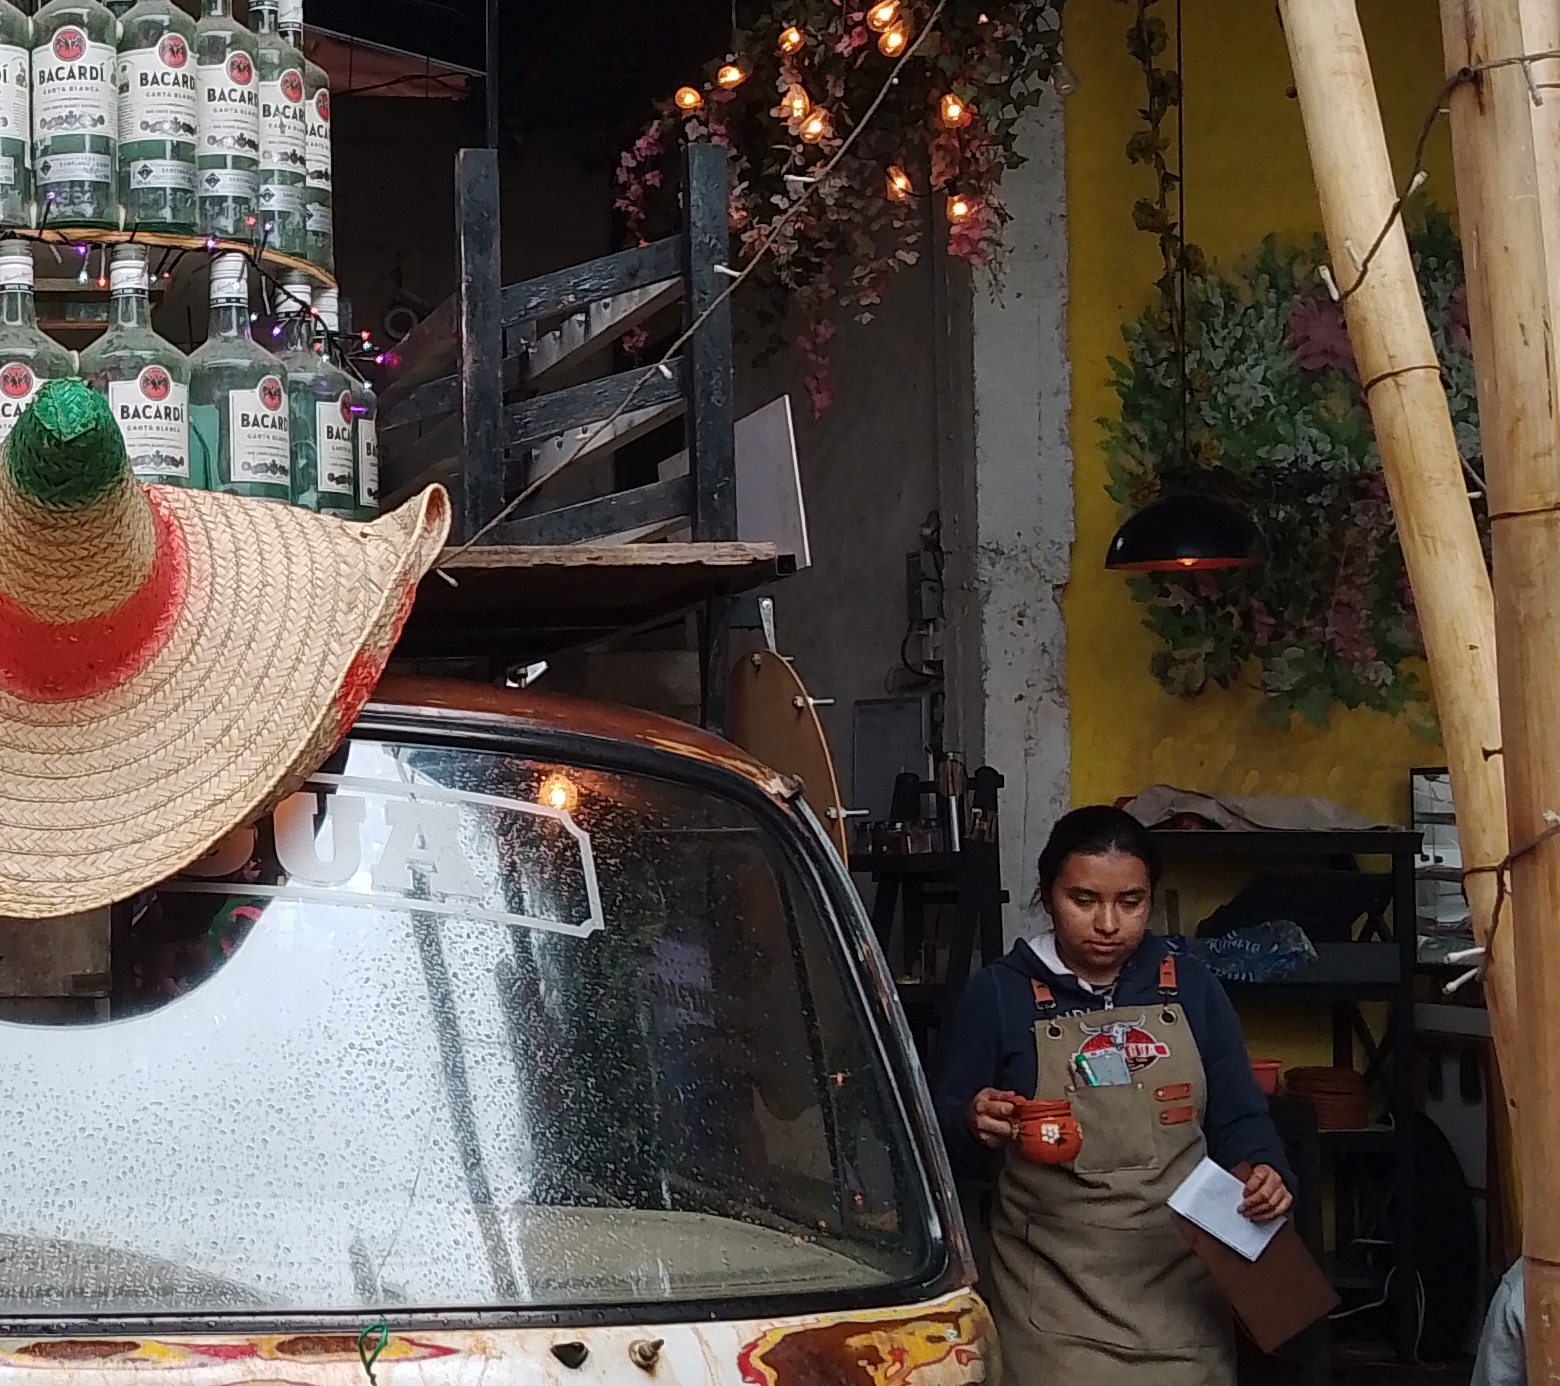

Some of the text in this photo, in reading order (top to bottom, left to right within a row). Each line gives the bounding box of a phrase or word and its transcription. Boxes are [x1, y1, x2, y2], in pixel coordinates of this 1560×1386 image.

[39, 62, 106, 85] BACARDÍ
[139, 71, 196, 91] BACARD
[207, 88, 258, 108] BACARD
[262, 103, 305, 124] BACAR
[120, 403, 185, 424] BACARDÍ
[240, 413, 288, 432] BACARD
